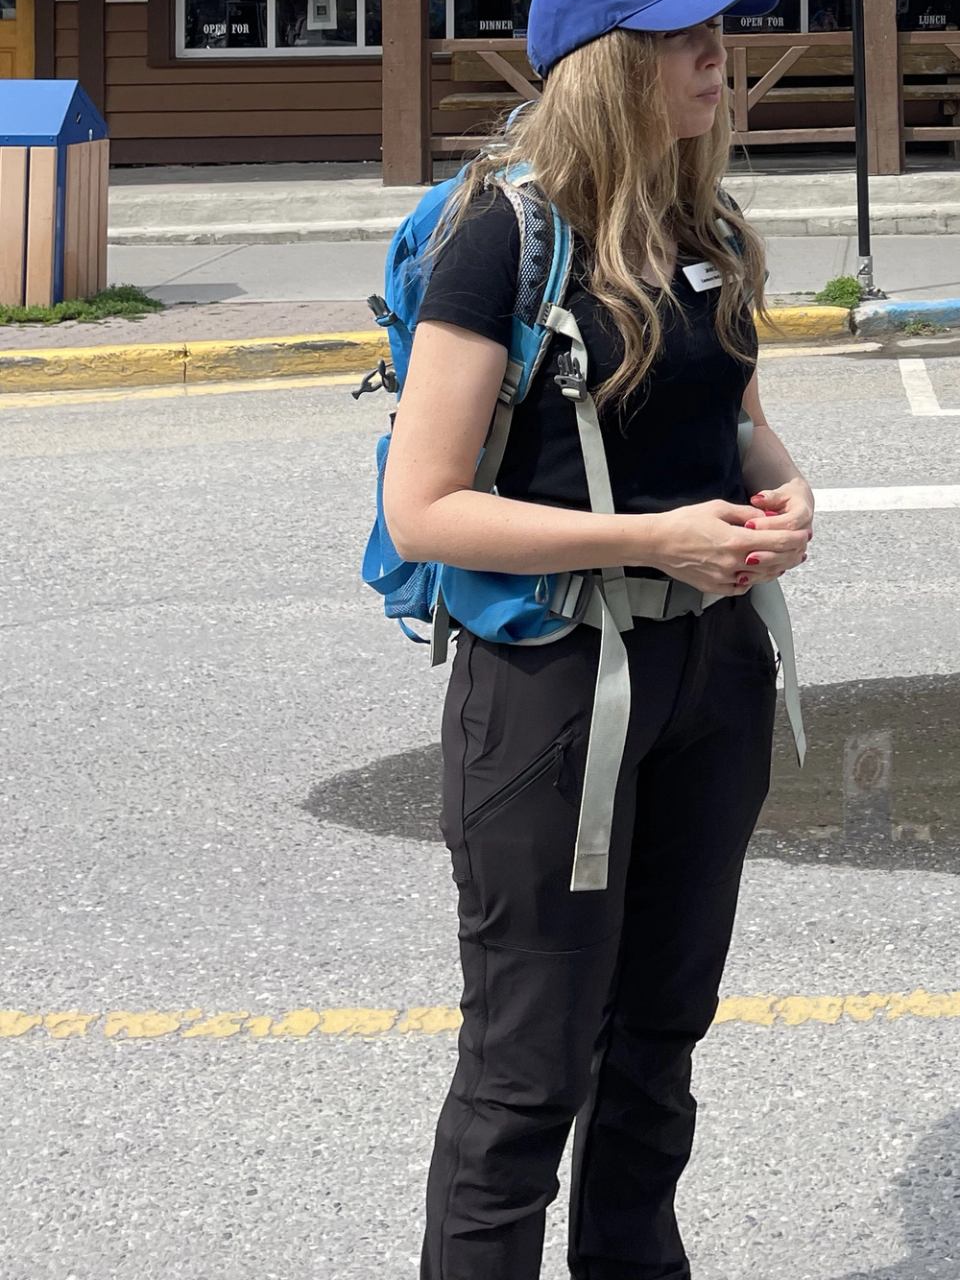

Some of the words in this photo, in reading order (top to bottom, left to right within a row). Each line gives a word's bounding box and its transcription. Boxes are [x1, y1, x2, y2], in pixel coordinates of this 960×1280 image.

[479, 20, 514, 31] DINNER
[740, 16, 763, 27] OPEN
[767, 16, 784, 27] FOR
[919, 15, 947, 25] LUNCH
[203, 23, 227, 34] OPEN
[231, 23, 250, 34] FOR
